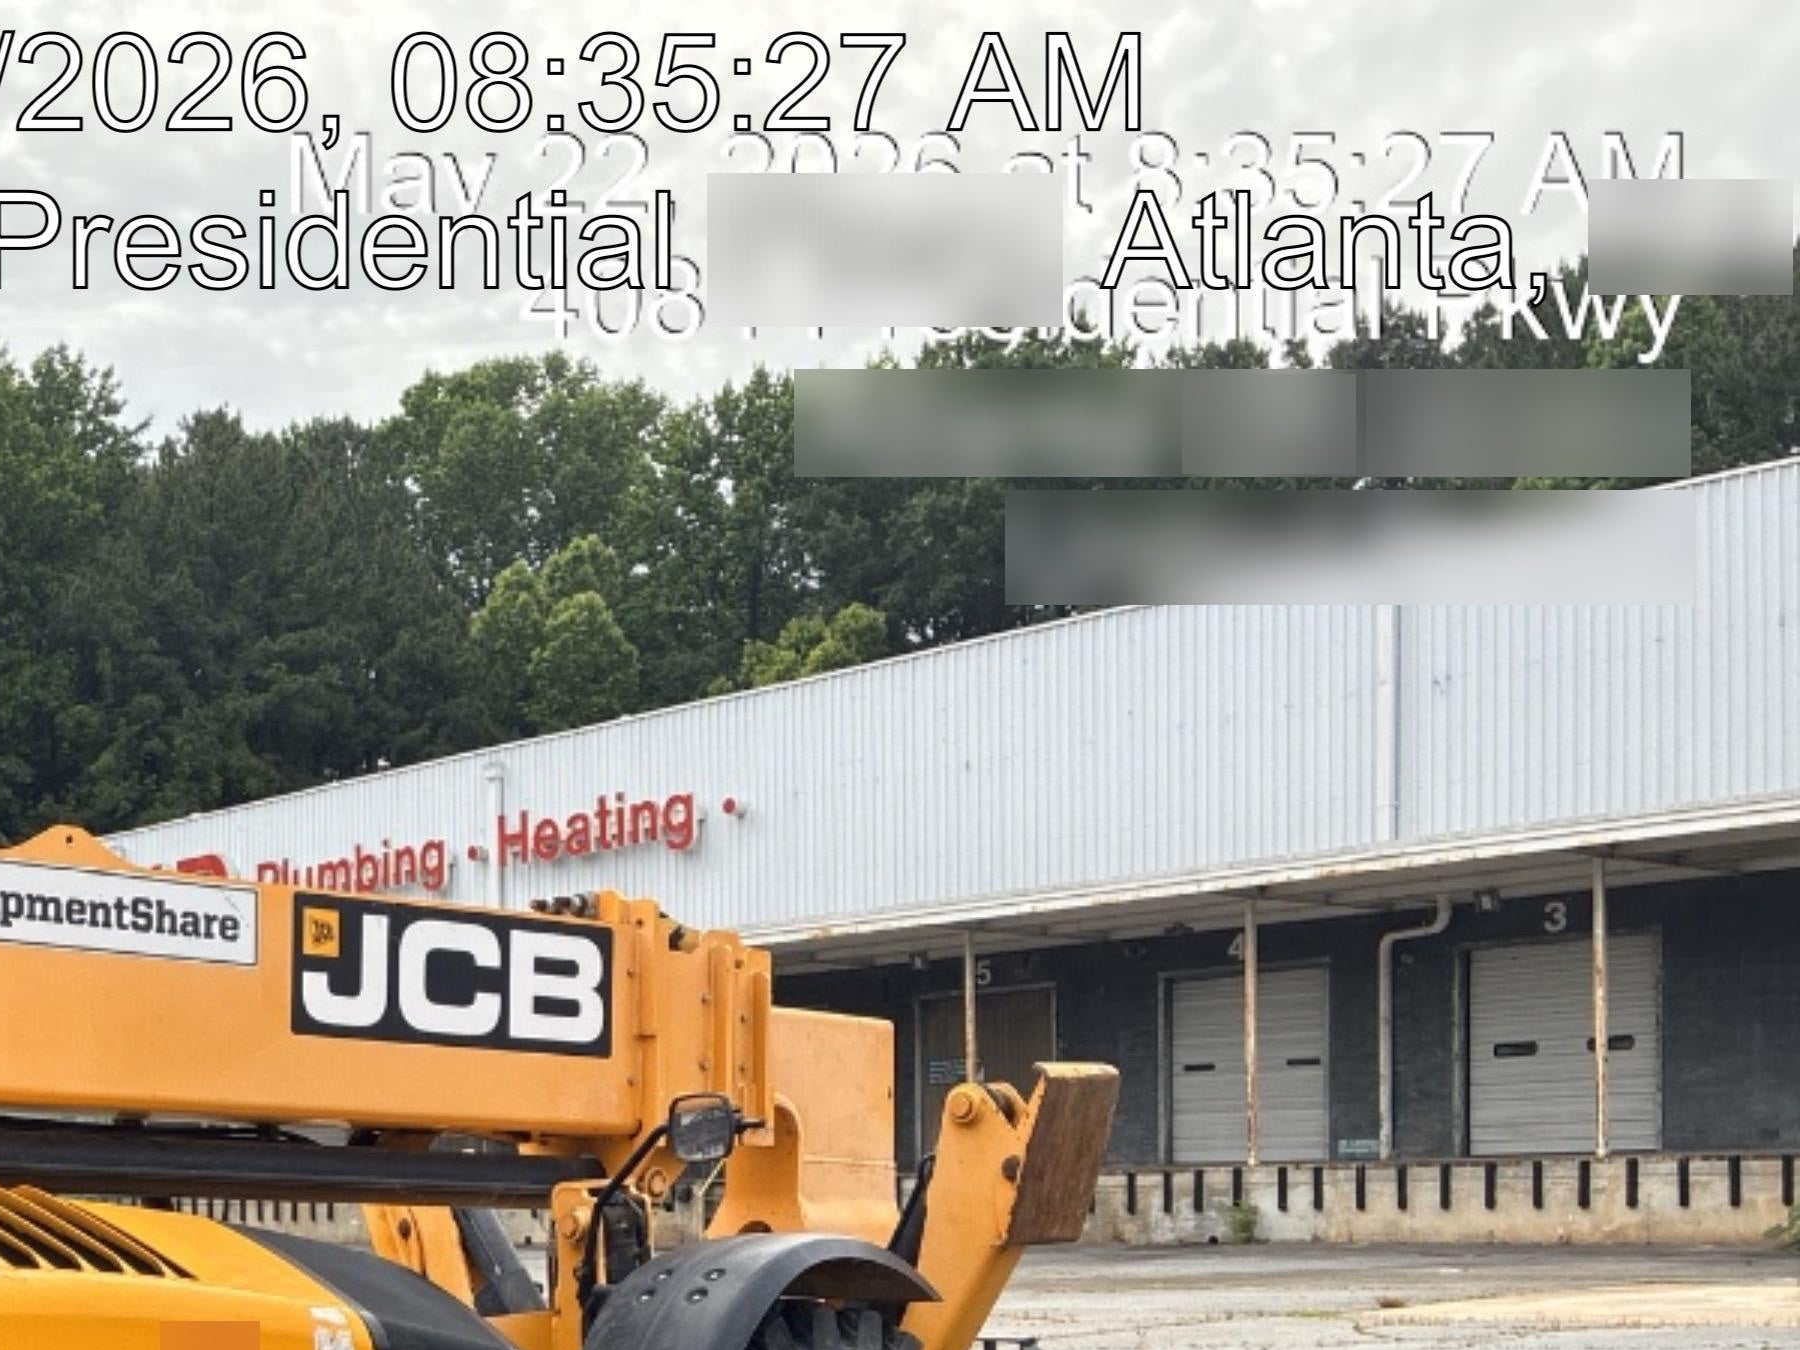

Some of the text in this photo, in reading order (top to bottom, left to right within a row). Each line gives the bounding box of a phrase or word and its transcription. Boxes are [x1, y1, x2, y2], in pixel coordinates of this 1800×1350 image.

[497, 791, 695, 867] Heating
[1544, 902, 1567, 933] 3
[301, 911, 605, 1044] JCB
[975, 959, 992, 985] 5
